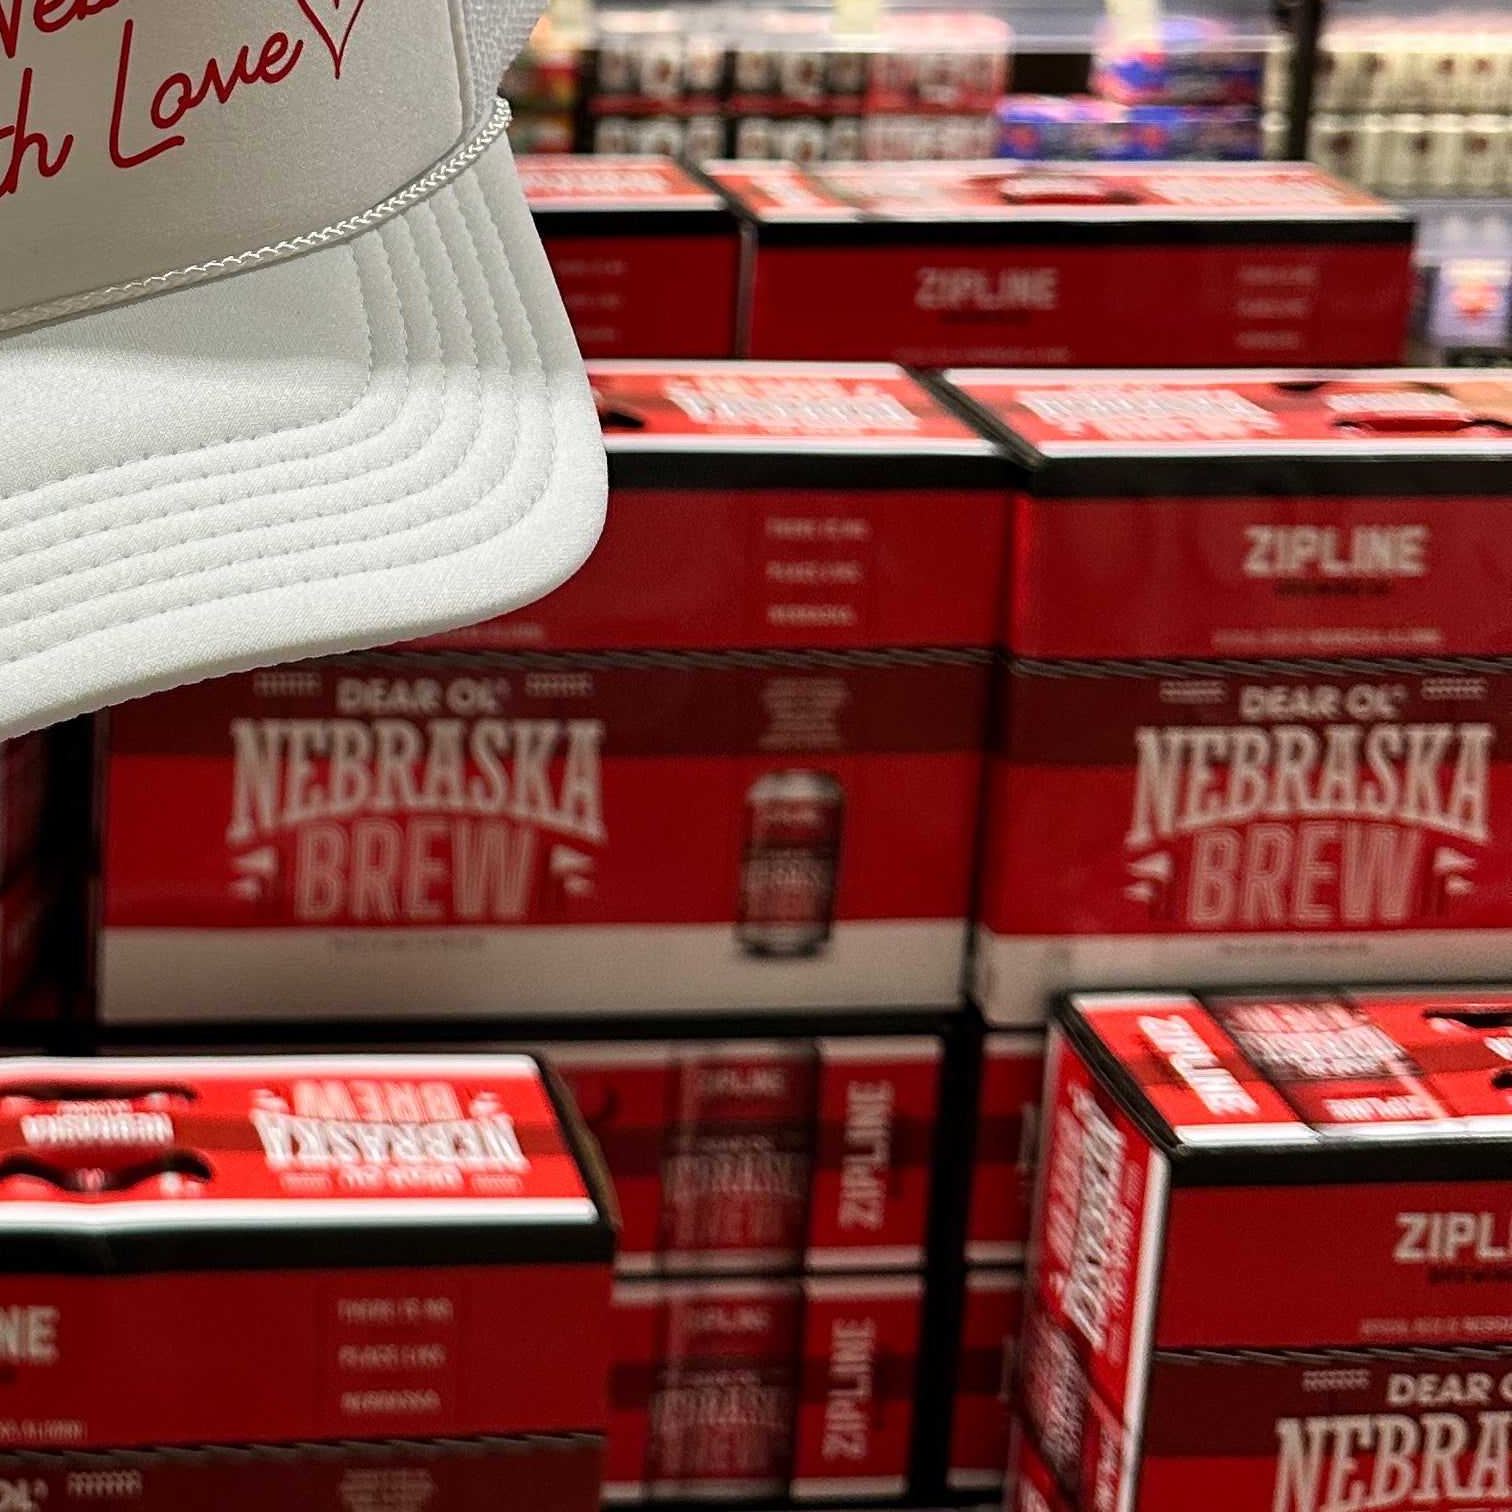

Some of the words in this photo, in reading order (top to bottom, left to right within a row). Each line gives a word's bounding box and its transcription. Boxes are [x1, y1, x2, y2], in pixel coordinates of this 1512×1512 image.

[109, 19, 303, 168] Love
[913, 265, 1062, 311] ZIPLINE
[1243, 524, 1430, 579] ZIPLINE
[336, 678, 442, 714] DEAR
[1238, 685, 1343, 722] DEAR
[226, 718, 607, 848] NEBRASKA
[1124, 722, 1495, 852] NEBRASKA
[294, 816, 537, 922] BREW
[1191, 820, 1424, 928] BREW
[836, 1078, 895, 1231] ZIPLINE
[821, 1317, 875, 1461] ZIPLINE
[1386, 1371, 1499, 1407] DEAR
